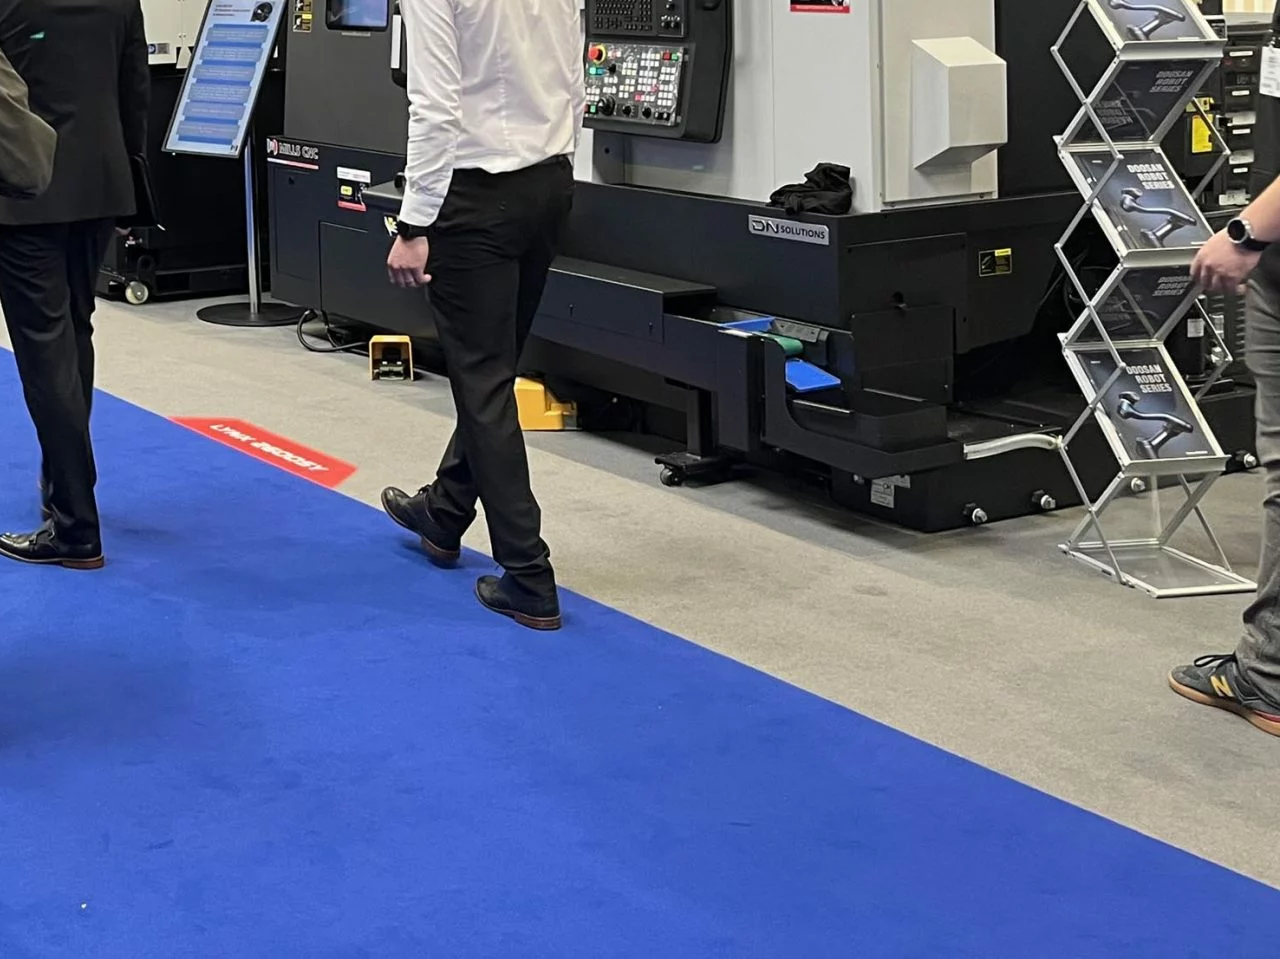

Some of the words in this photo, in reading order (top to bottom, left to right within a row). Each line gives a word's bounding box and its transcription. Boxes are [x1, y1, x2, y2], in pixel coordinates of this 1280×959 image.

[1126, 163, 1165, 173] DOOSAN
[1136, 172, 1170, 182] ROBOT
[751, 220, 779, 234] DN
[780, 225, 825, 240] SOLUTIONS
[1134, 373, 1167, 384] ROBOT
[1139, 382, 1173, 394] SERIES
